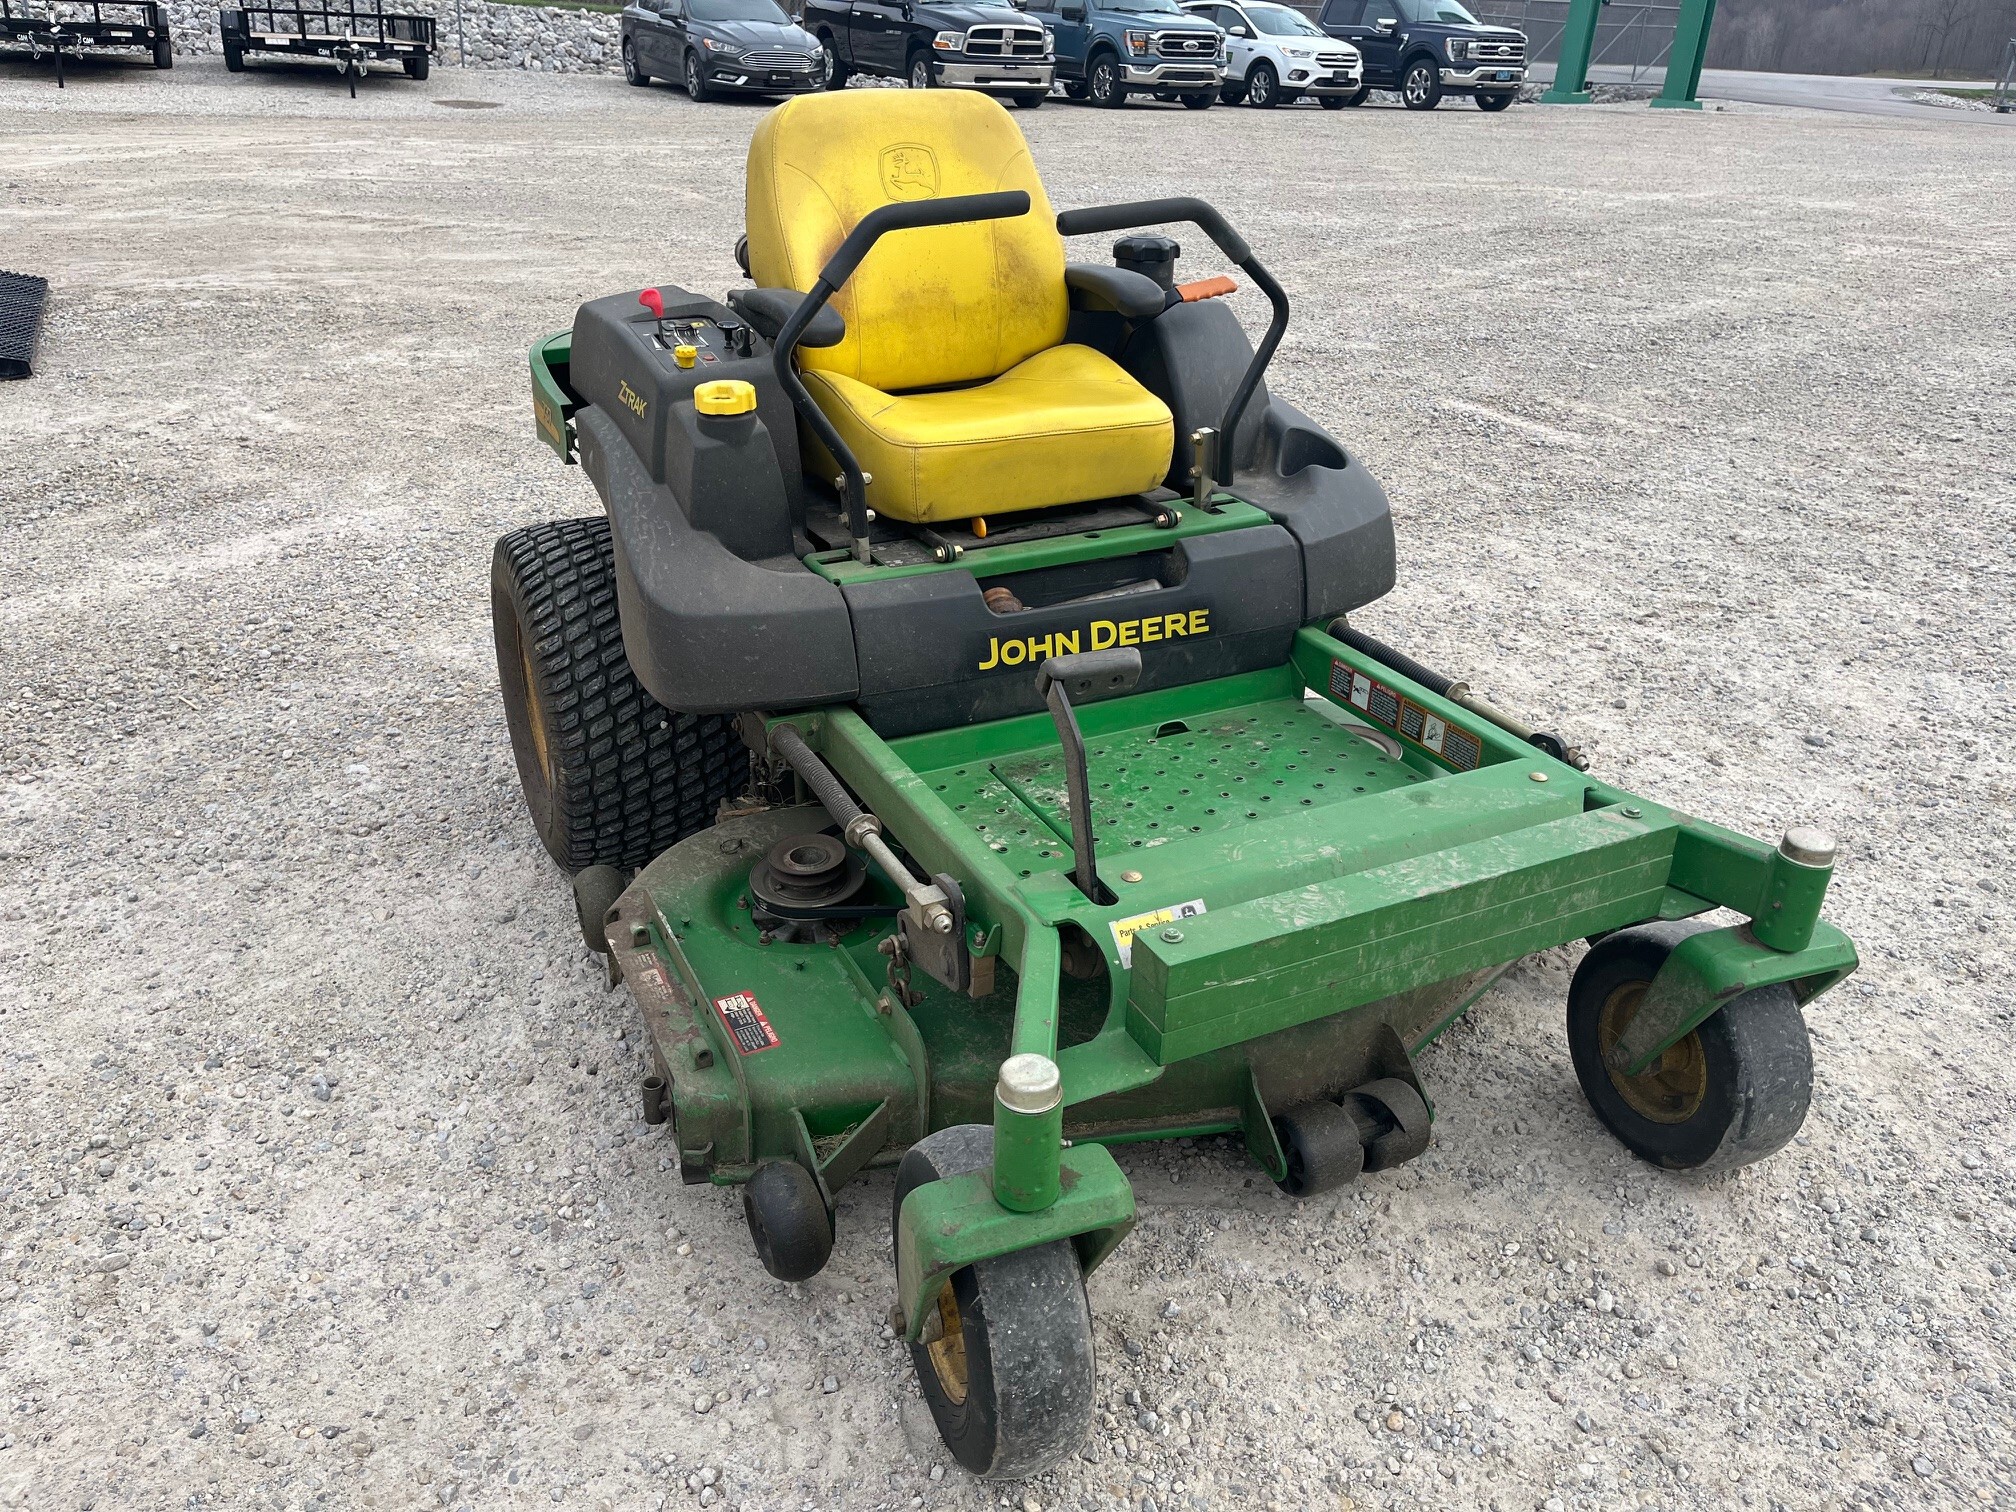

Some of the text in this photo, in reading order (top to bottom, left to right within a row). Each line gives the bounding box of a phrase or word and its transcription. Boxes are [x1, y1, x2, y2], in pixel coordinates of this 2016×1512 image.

[618, 380, 648, 420] ZTRAK
[979, 609, 1210, 671] JOHN DEERE
